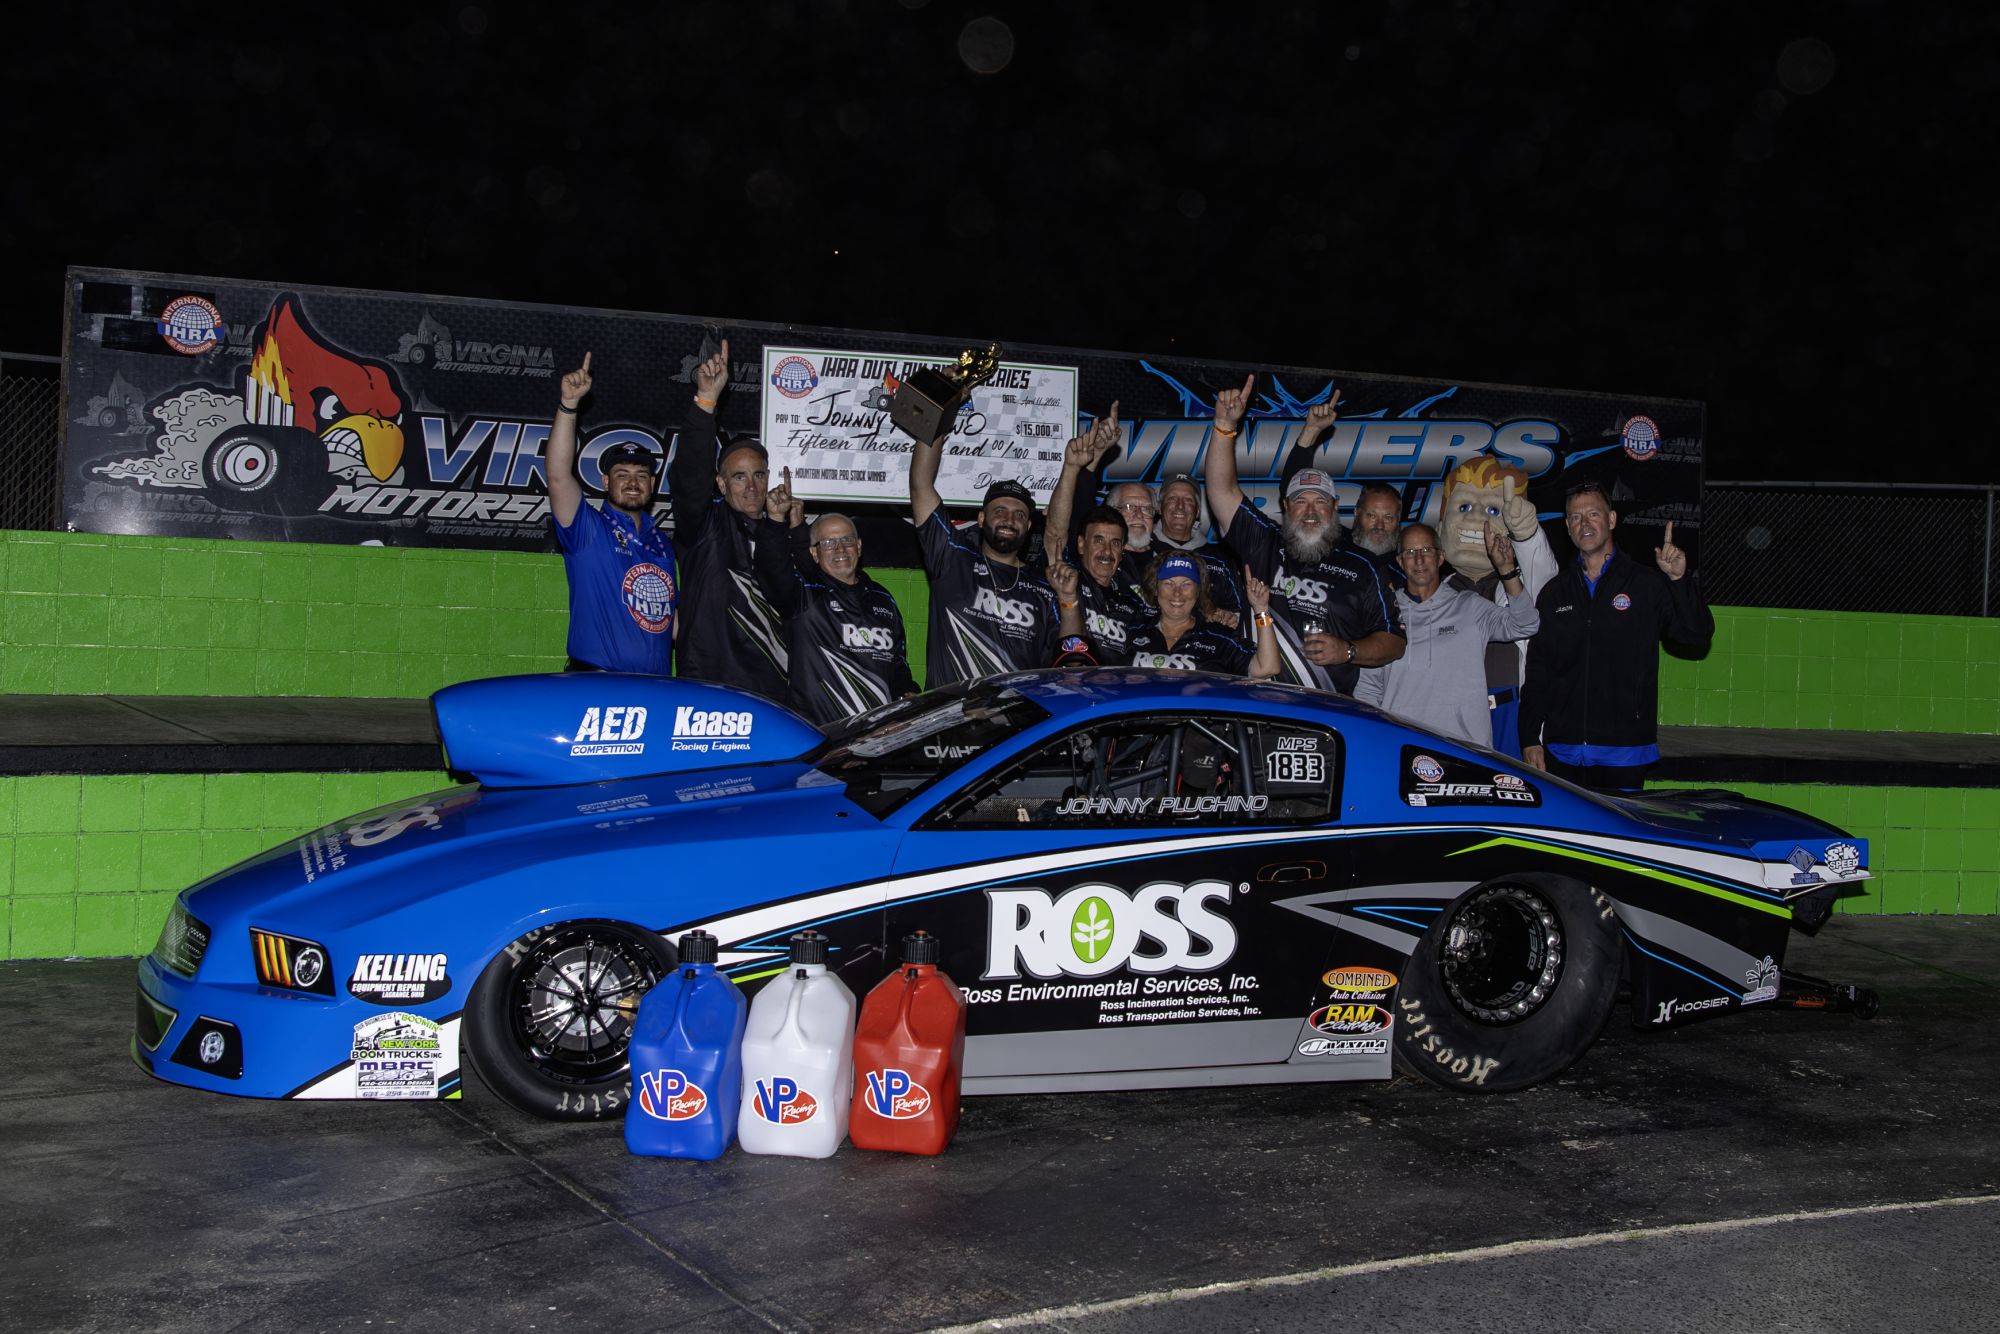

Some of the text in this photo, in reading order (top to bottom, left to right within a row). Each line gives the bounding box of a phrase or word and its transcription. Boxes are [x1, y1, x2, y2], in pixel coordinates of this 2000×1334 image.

[162, 296, 222, 325] INTERNATIONAL
[164, 326, 217, 341] IHRA
[455, 340, 555, 368] VIRGINIA
[433, 361, 556, 378] MOTORSPORTS PARK
[774, 357, 816, 375] INTERNATIONAL
[821, 357, 858, 378] IHRA
[861, 359, 926, 382] OUTLA
[980, 367, 1031, 390] ERIES
[776, 377, 813, 388] IHRA
[775, 413, 788, 424] PAY
[790, 414, 800, 424] TO:
[807, 390, 888, 438] JOHNNY
[1622, 415, 1660, 439] INTERNATIONAL
[787, 428, 853, 456] Fifteen
[950, 438, 989, 457] and
[1038, 451, 1062, 462] DOLLARS
[1624, 438, 1658, 450] IHRA
[821, 468, 838, 480] MOTOR
[839, 469, 849, 480] PRO
[850, 470, 865, 481] STOCK
[867, 471, 887, 482] WINNER
[1166, 559, 1193, 570] IHRA
[1319, 563, 1358, 579] PLUCHINO
[627, 593, 672, 616] IHRA
[972, 584, 1035, 628] ROSS
[1085, 607, 1128, 642] ROSS
[841, 623, 894, 651] ROSS
[574, 706, 648, 742] AED
[673, 706, 753, 736] Kaase
[572, 744, 642, 755] COMPETITION
[672, 741, 751, 753] Racing Engines
[1277, 736, 1317, 751] MPS
[1266, 752, 1326, 784] 1833
[1416, 768, 1441, 777] IHRA
[1439, 783, 1492, 796] HAAS
[1056, 795, 1268, 815] JOHNNY PLUCHINO
[1829, 860, 1859, 870] SPEED
[981, 880, 1237, 979] ROSS
[353, 953, 448, 982] KELLING
[352, 983, 426, 993] EQUIPMENT REPAIR
[1007, 978, 1138, 1002] Environmental
[1143, 974, 1223, 996] Services,
[1229, 974, 1260, 991] Inc.
[1327, 972, 1391, 987] COMBINED
[1100, 993, 1251, 1011] Ross Incineration Services, Inc.
[1329, 989, 1387, 1000] Auto Collision
[1674, 996, 1730, 1013] HOOSIER
[1098, 1006, 1262, 1024] Ross Transportation Services, Inc.
[1325, 1005, 1377, 1023] RAM
[380, 1040, 438, 1049] NEW YORK
[1400, 998, 1500, 1086] Hoosier
[351, 1050, 385, 1059] BOOM
[388, 1050, 430, 1059] TRUCKS
[641, 1069, 687, 1119] VP
[754, 1075, 799, 1125] VP
[866, 1069, 911, 1118] VP
[671, 1097, 705, 1115] Racing
[783, 1102, 818, 1120] Racing
[895, 1096, 931, 1114] Racing
